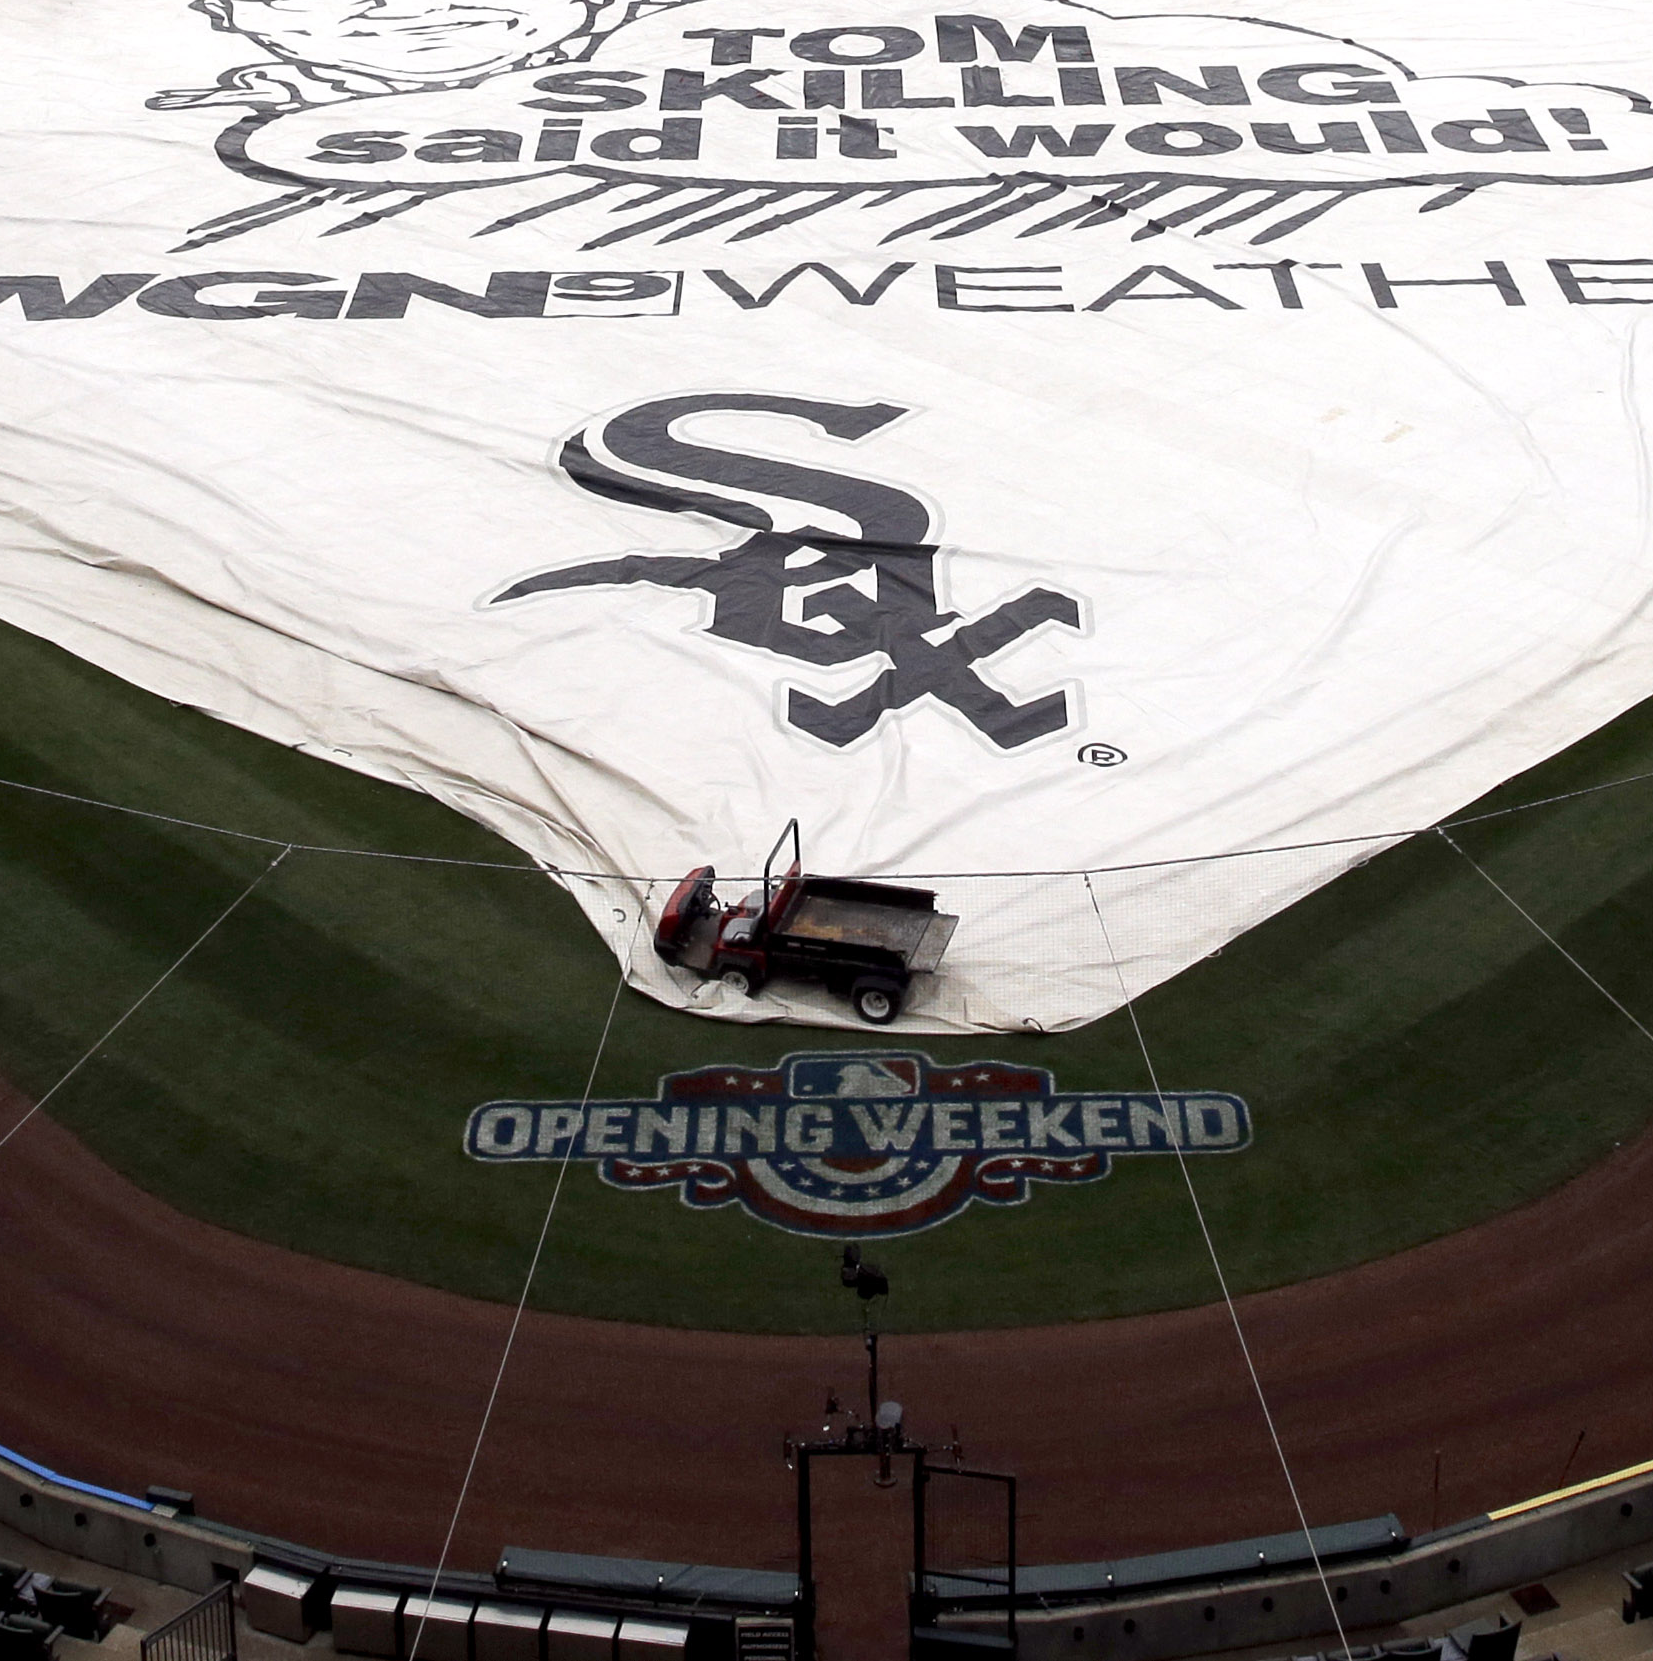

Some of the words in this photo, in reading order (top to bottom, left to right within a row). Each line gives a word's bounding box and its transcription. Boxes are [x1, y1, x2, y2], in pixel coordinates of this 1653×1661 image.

[683, 15, 1094, 67] TOM
[518, 62, 1399, 112] SKILLING
[308, 117, 700, 164] said
[776, 115, 897, 160] it
[954, 108, 1608, 159] would!
[476, 1103, 836, 1155] OPENING
[847, 1097, 1244, 1154] WEEKEND
